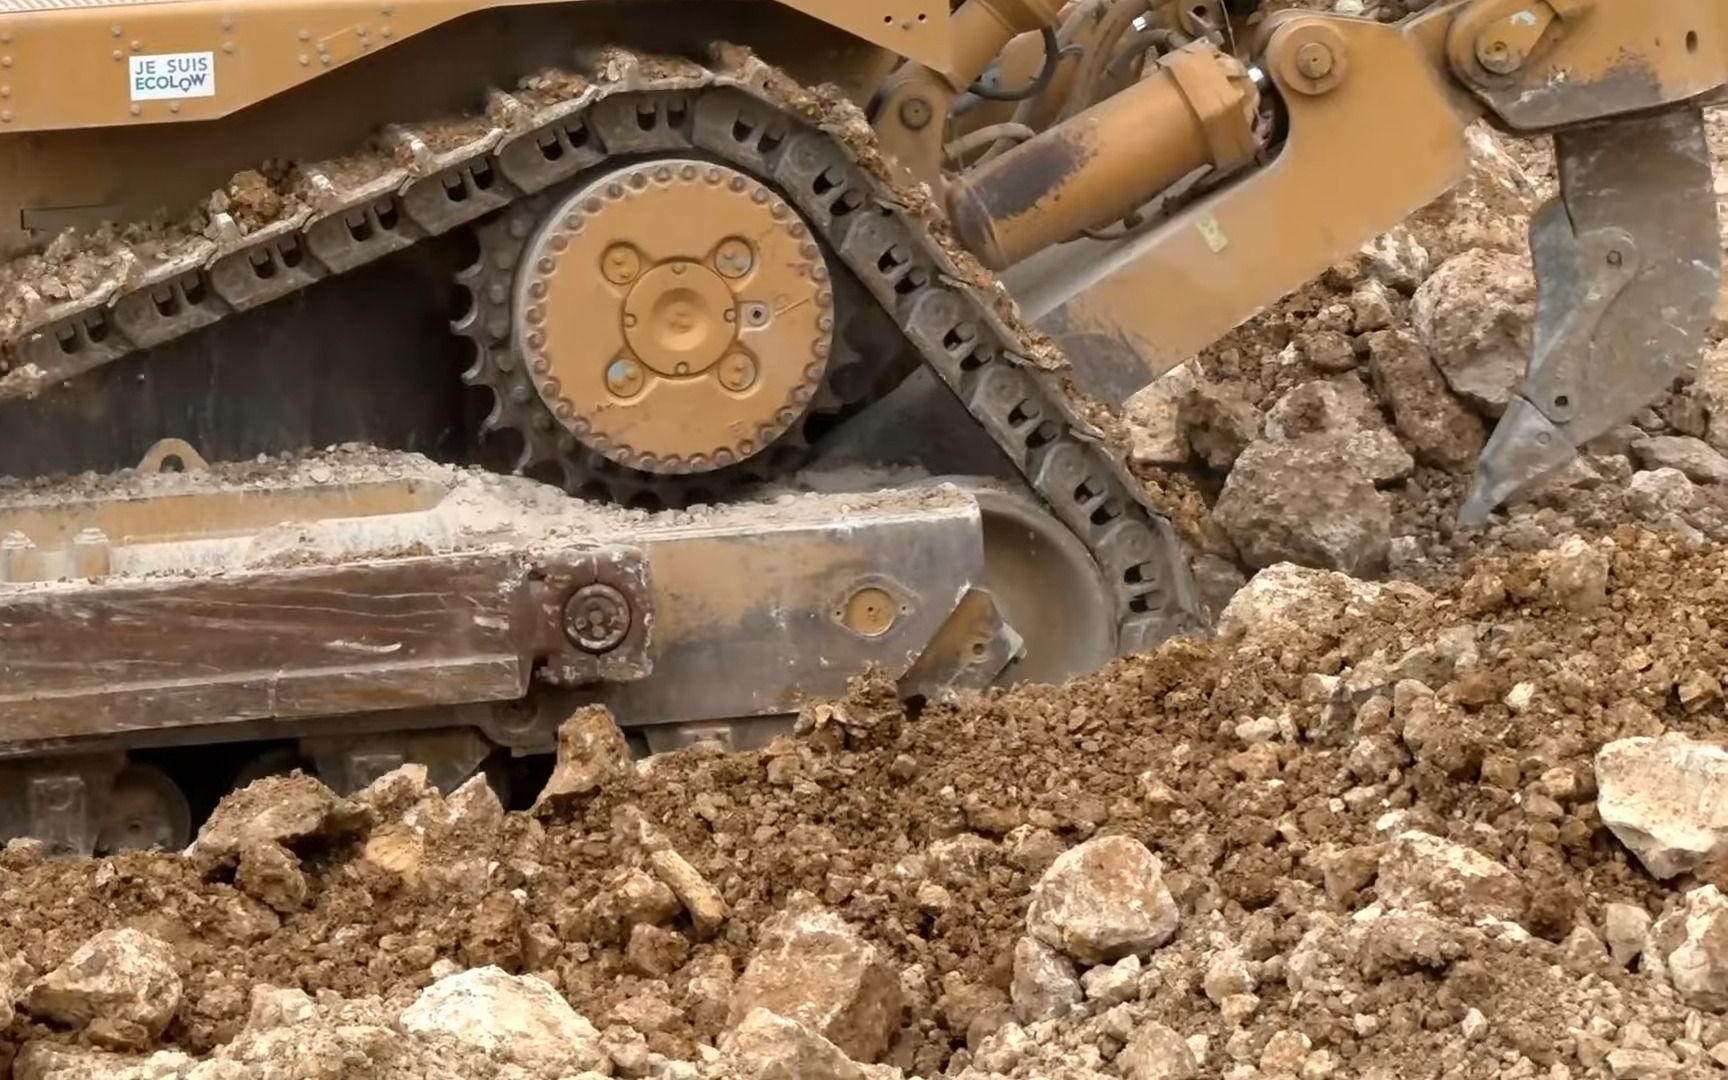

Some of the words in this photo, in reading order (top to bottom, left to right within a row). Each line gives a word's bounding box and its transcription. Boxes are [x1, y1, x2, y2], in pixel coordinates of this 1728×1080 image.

[135, 60, 157, 76] JE
[167, 57, 208, 73] SUIS
[135, 73, 206, 93] ECOLOW
